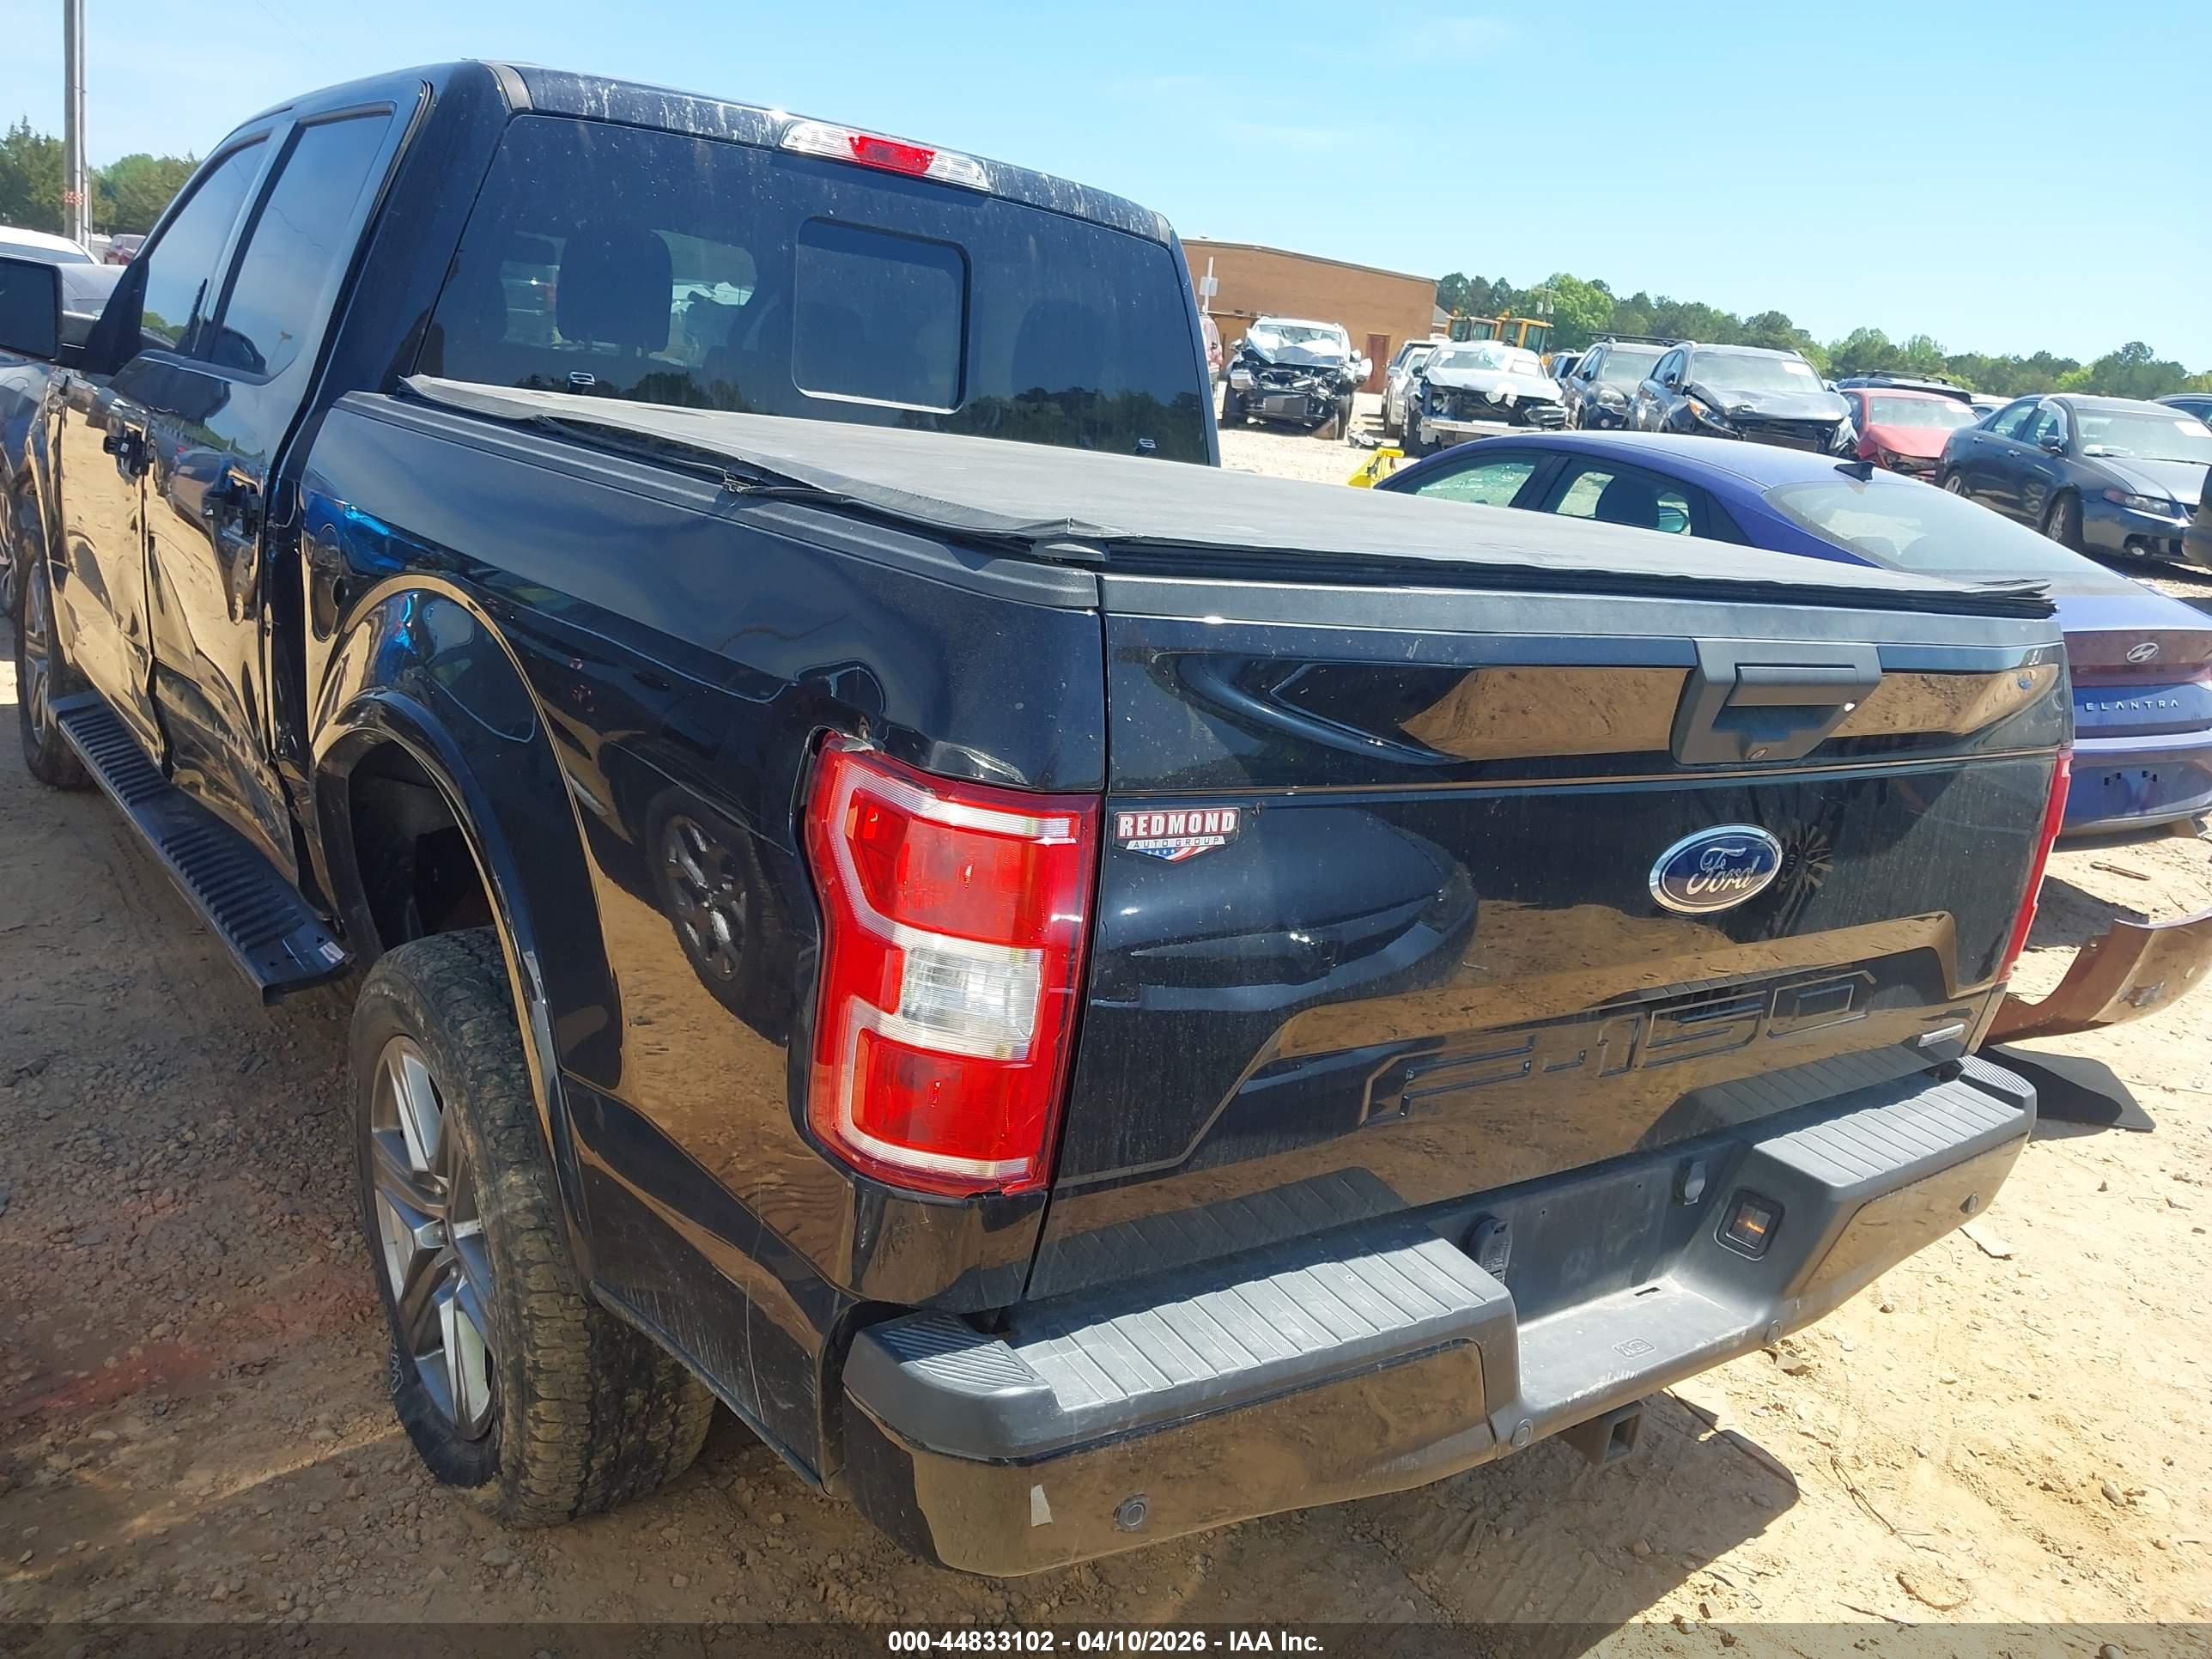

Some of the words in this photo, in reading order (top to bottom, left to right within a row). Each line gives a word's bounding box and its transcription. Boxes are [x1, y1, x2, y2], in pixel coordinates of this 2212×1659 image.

[2085, 699, 2179, 712] ELANTRA
[1118, 811, 1236, 837] REDMOND
[1133, 839, 1169, 848] AUTO
[1175, 836, 1219, 847] GROUP
[1686, 846, 1760, 896] Ford
